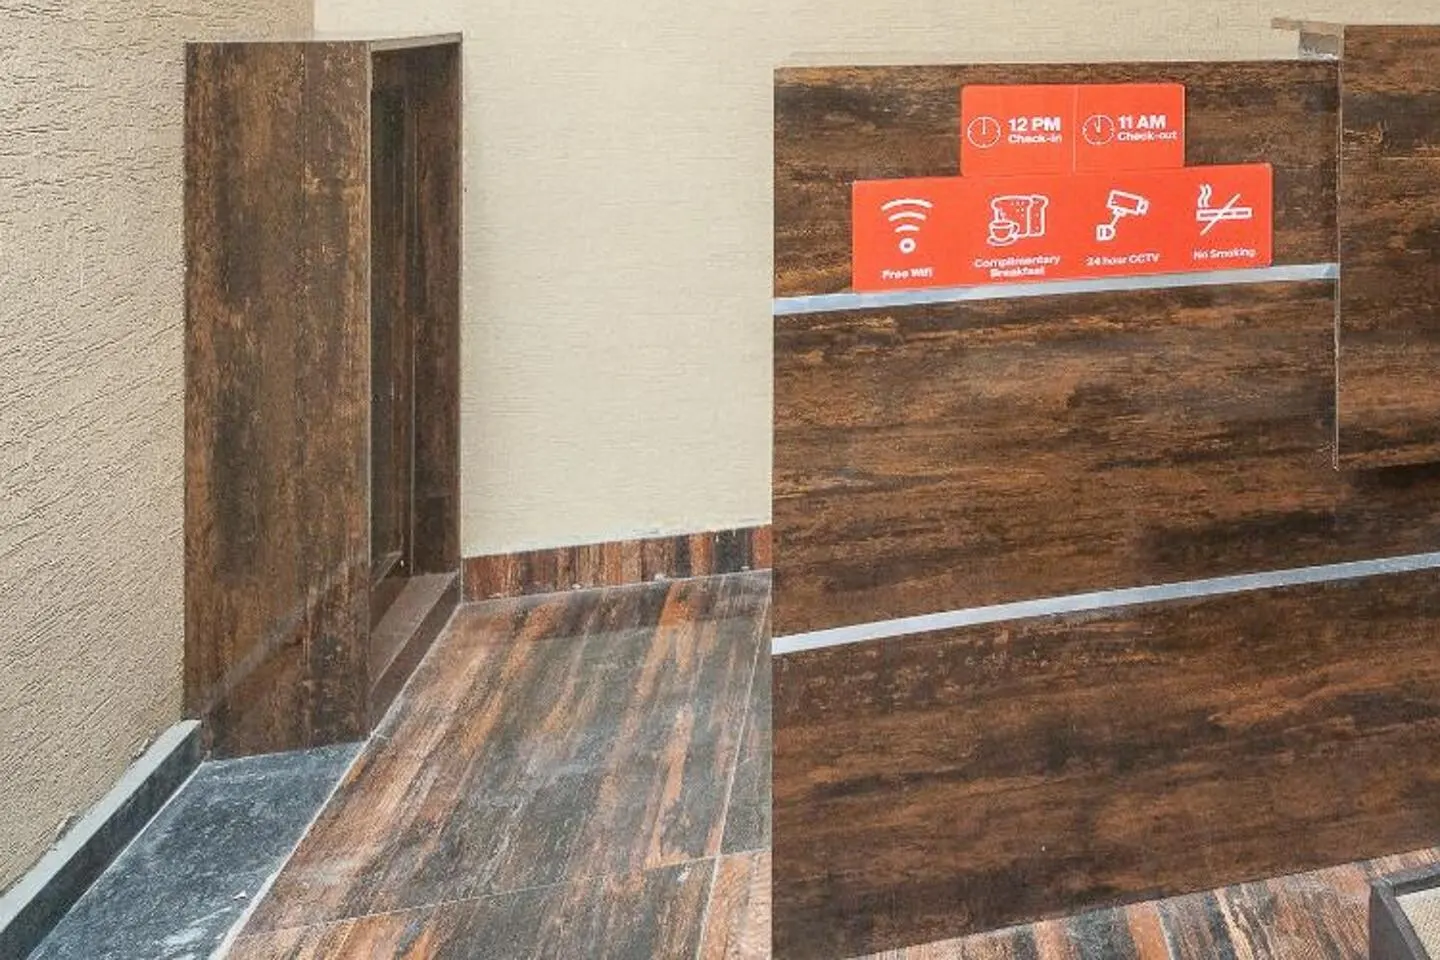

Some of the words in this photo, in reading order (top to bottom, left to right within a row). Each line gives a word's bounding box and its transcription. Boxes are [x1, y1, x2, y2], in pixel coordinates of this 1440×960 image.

[1008, 117, 1028, 132] 12
[1031, 117, 1062, 132] PM
[1118, 116, 1133, 130] 11
[1136, 115, 1167, 130] AM
[1008, 133, 1062, 144] Check-in
[1117, 130, 1178, 142] Check-out
[1086, 256, 1101, 266] 24
[1128, 252, 1160, 264] CCTV
[1193, 248, 1209, 260] No
[1210, 246, 1256, 259] Smoking
[974, 255, 1061, 269] Complimentary
[882, 269, 909, 280] Free
[990, 267, 1046, 279] Breakfast
